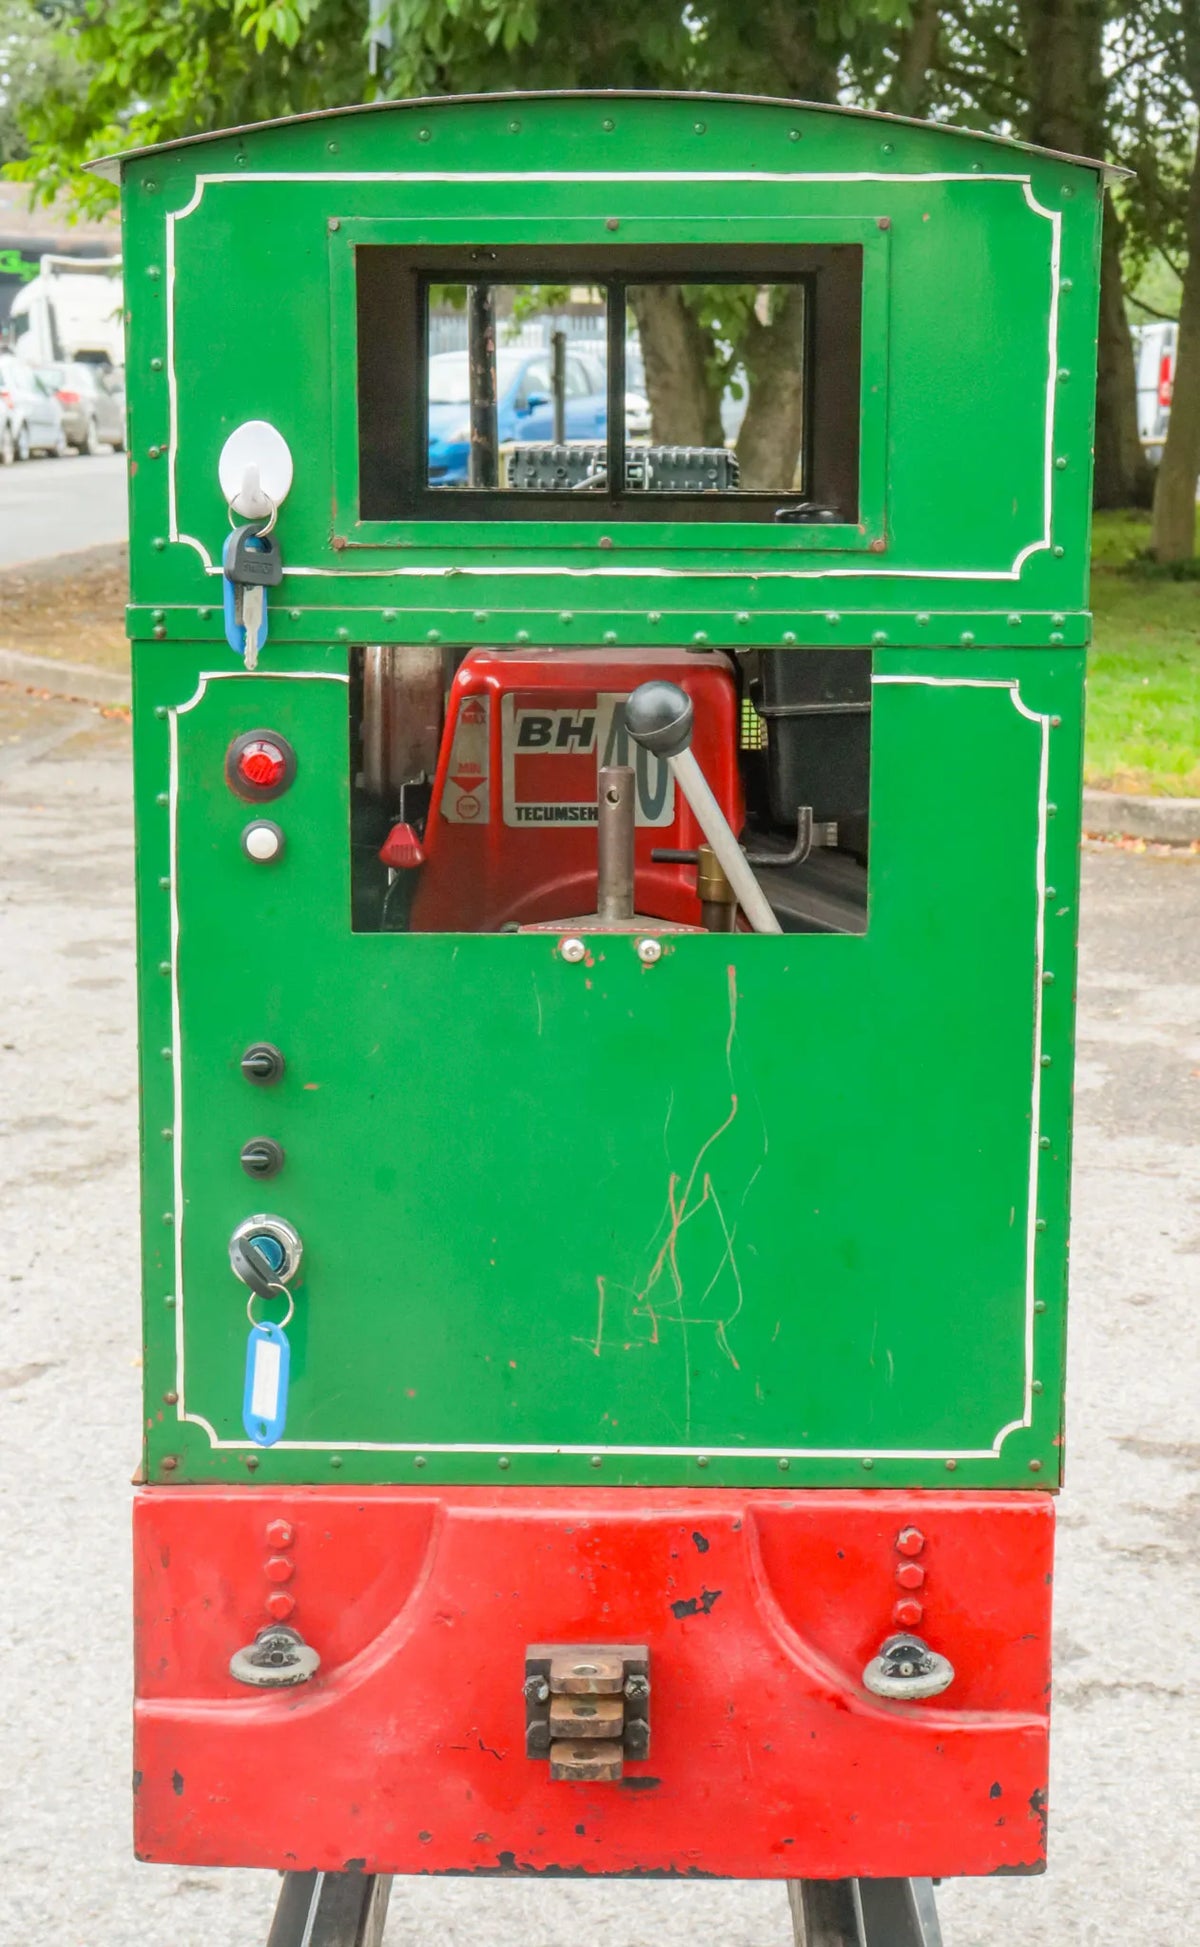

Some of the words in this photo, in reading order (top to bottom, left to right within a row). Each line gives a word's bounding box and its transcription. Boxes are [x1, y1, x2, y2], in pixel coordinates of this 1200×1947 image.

[517, 717, 596, 747] BH
[457, 762, 481, 773] MIN
[515, 806, 599, 821] TECUMSEH
